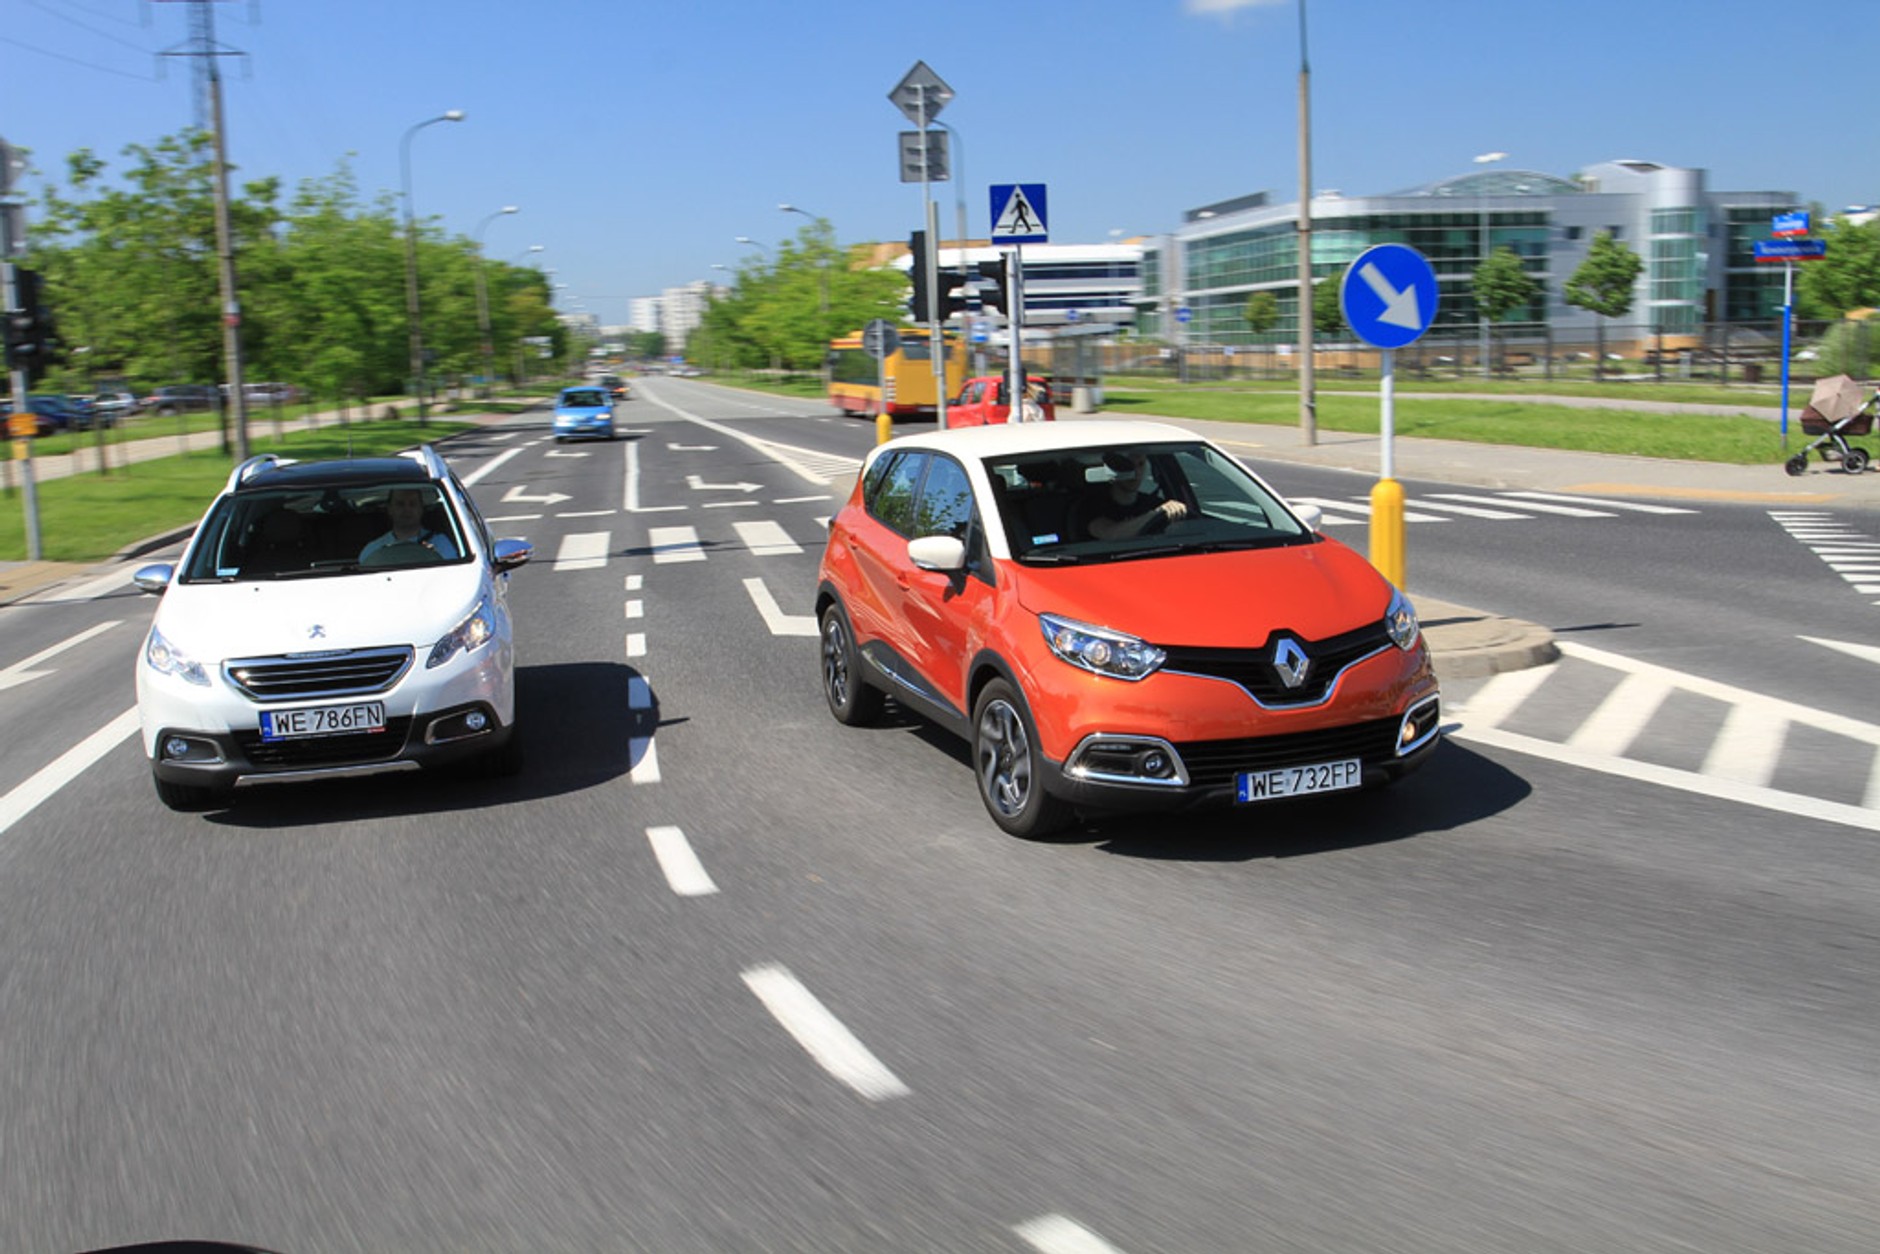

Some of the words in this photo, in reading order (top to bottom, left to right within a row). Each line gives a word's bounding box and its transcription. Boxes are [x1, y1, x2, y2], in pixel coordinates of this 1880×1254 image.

[275, 713, 307, 733] WE
[314, 706, 380, 730] 786FN
[1252, 772, 1283, 797] WE
[1292, 762, 1358, 792] 732FP
